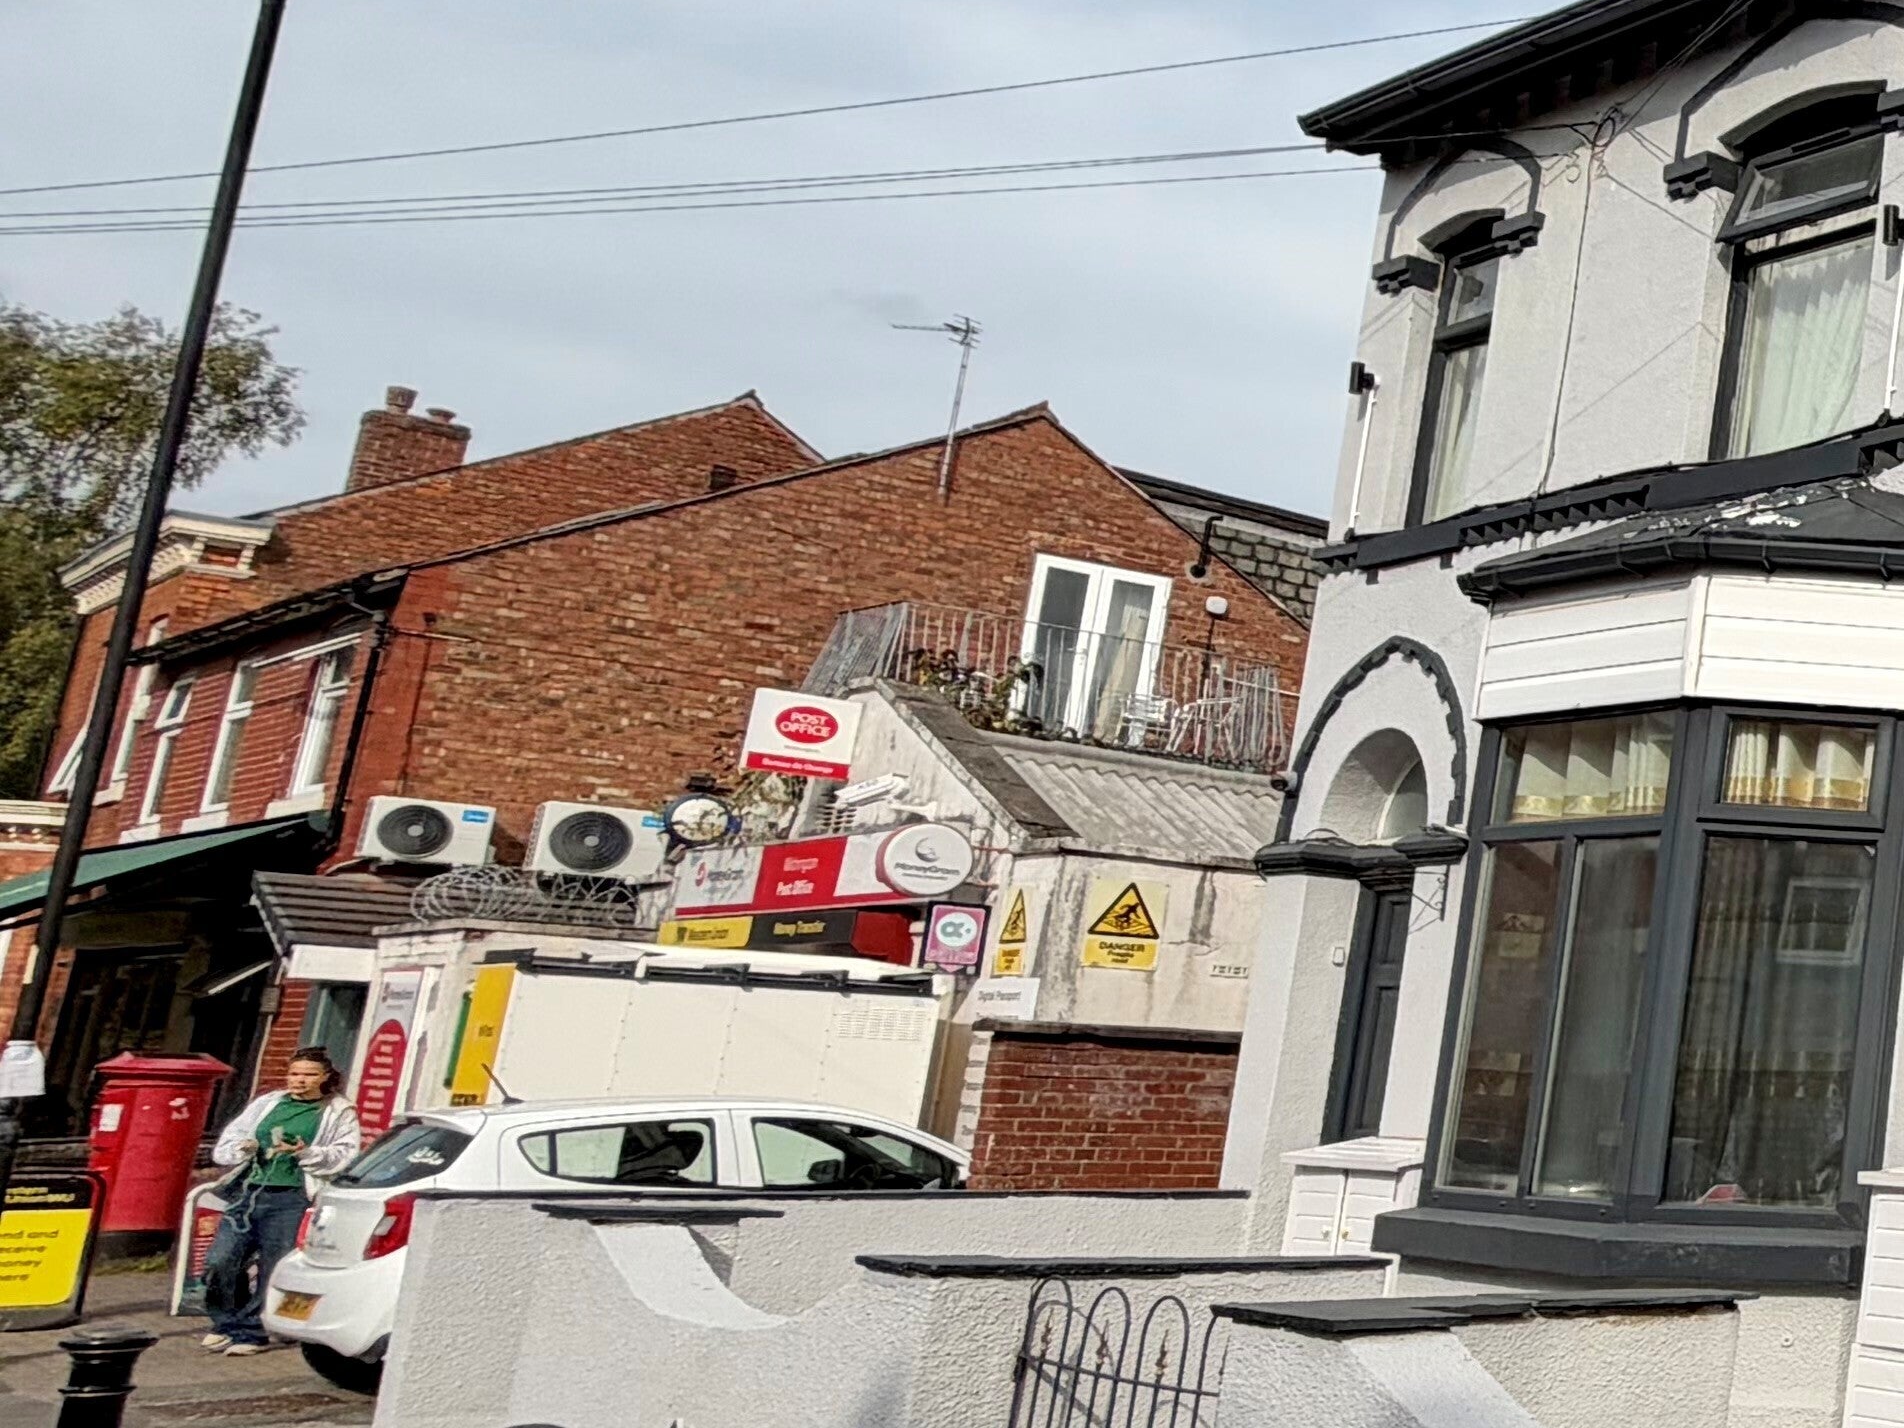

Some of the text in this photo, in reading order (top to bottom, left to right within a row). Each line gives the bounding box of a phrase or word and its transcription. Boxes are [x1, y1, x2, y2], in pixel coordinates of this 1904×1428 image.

[790, 711, 830, 726] POST
[780, 720, 831, 737] OFFICE
[1098, 941, 1146, 952] DANGER
[0, 1229, 60, 1239] nd and
